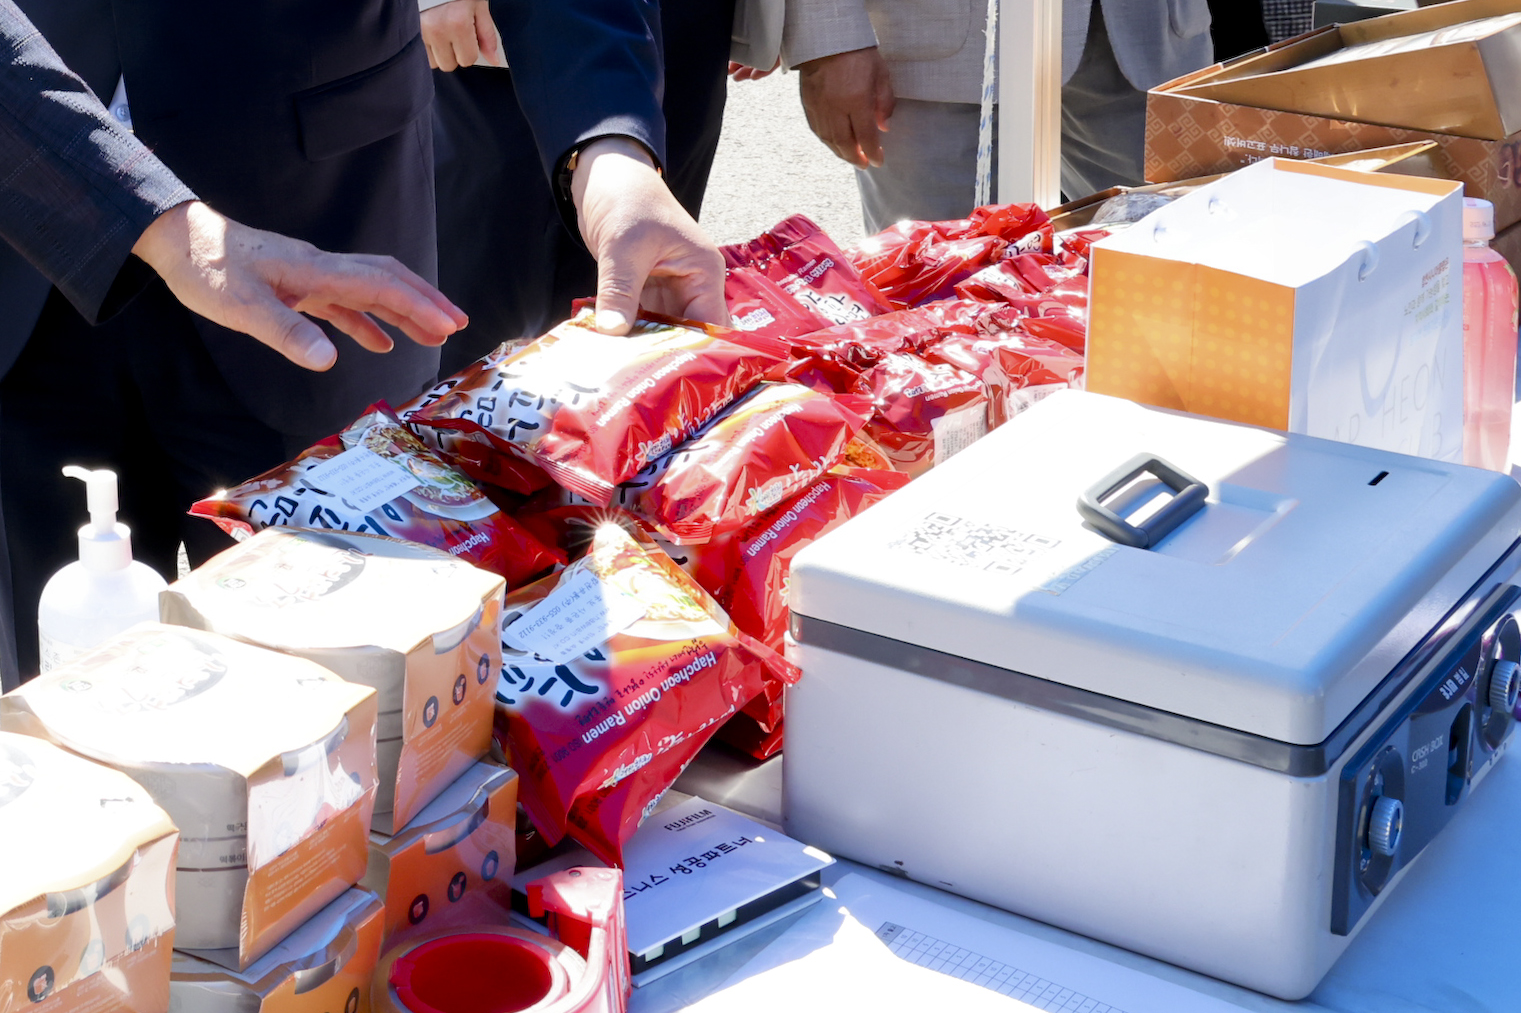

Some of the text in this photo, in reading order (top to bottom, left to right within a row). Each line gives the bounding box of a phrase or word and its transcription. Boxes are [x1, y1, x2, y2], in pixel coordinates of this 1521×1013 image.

[1223, 135, 1266, 151] 표고버섯!
[1269, 143, 1300, 156] 참나무
[650, 347, 697, 385] Hapcheon
[625, 375, 657, 403] Onion
[594, 395, 632, 428] Ramen
[735, 425, 765, 452] Onion
[790, 478, 832, 516] Hapcheon
[771, 509, 799, 534] Onion
[744, 527, 778, 558] Ramen
[515, 604, 563, 639] 055-933-9112
[642, 659, 670, 681] 생산된
[580, 648, 718, 745] Hapcheon Onion Ramen
[1411, 735, 1444, 762] CASH BOX
[664, 809, 712, 831] FUJIFILM
[669, 836, 753, 875] 성공파트너
